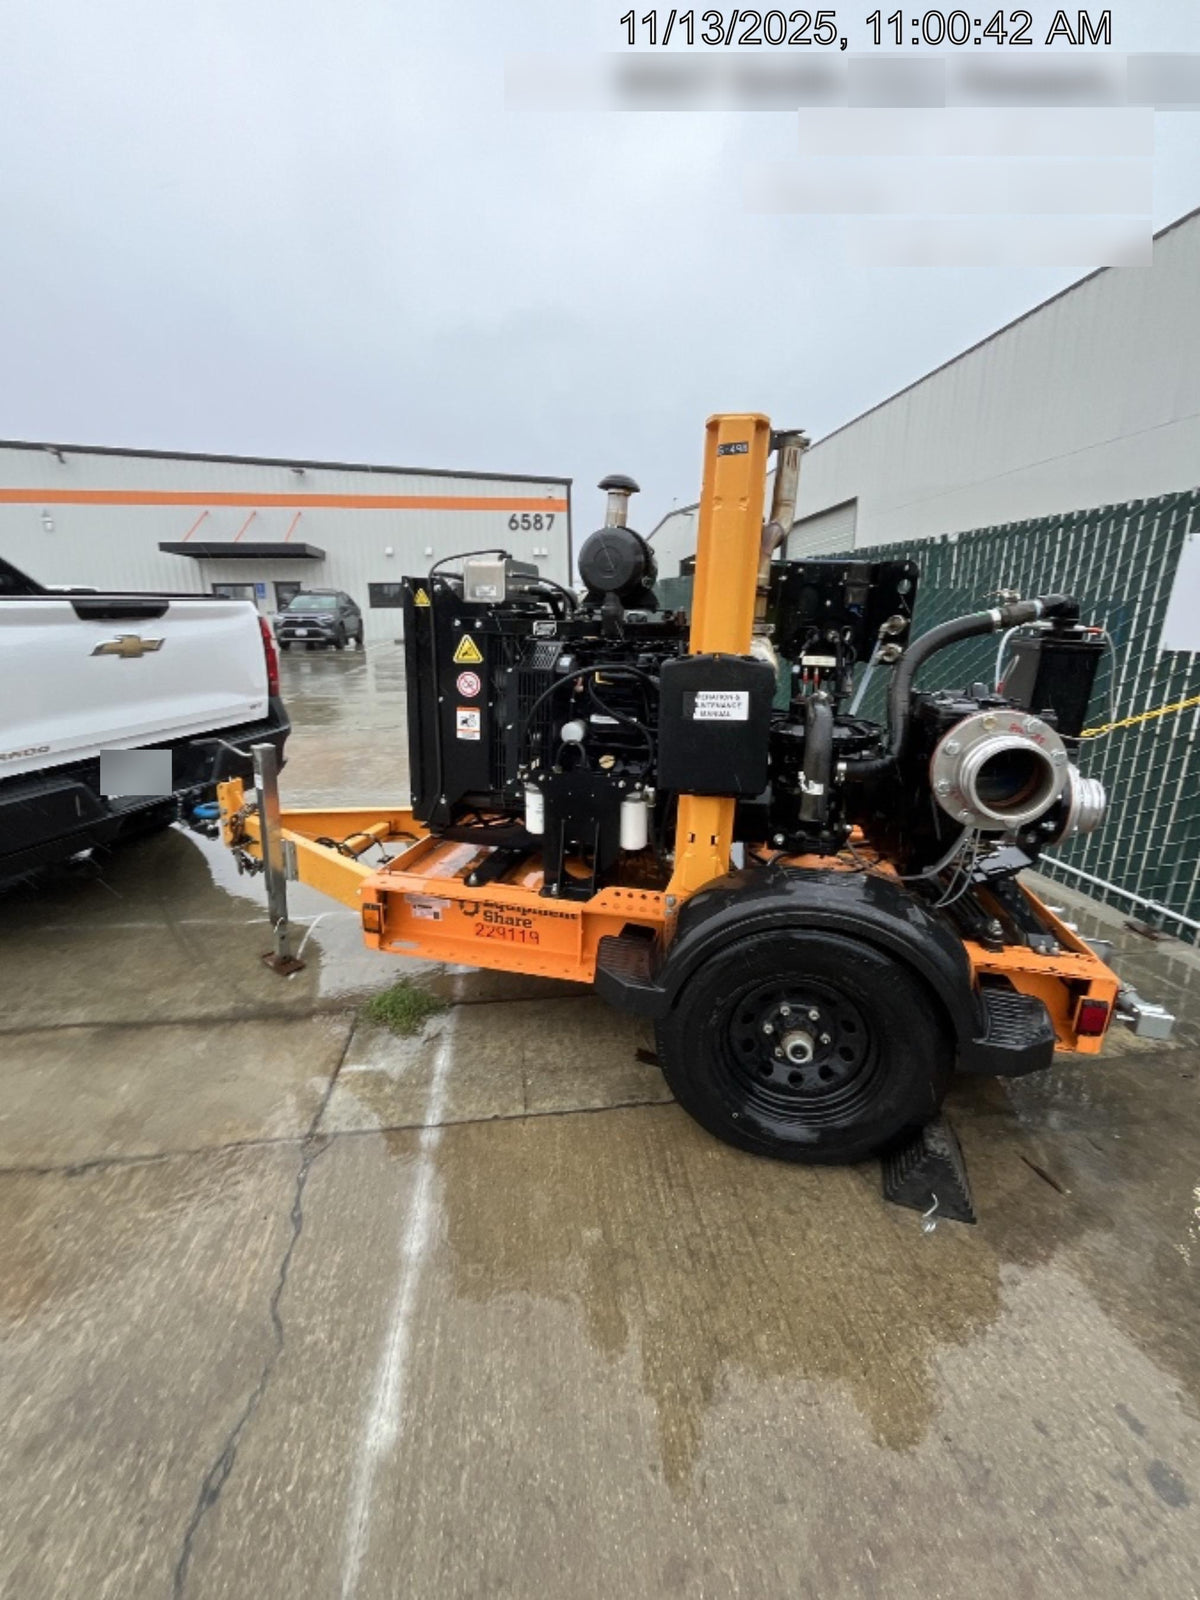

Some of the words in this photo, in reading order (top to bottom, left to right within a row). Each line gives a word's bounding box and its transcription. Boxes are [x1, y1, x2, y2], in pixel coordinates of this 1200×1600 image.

[508, 513, 555, 531] 6587
[482, 910, 533, 929] Share
[475, 922, 540, 945] 229119
